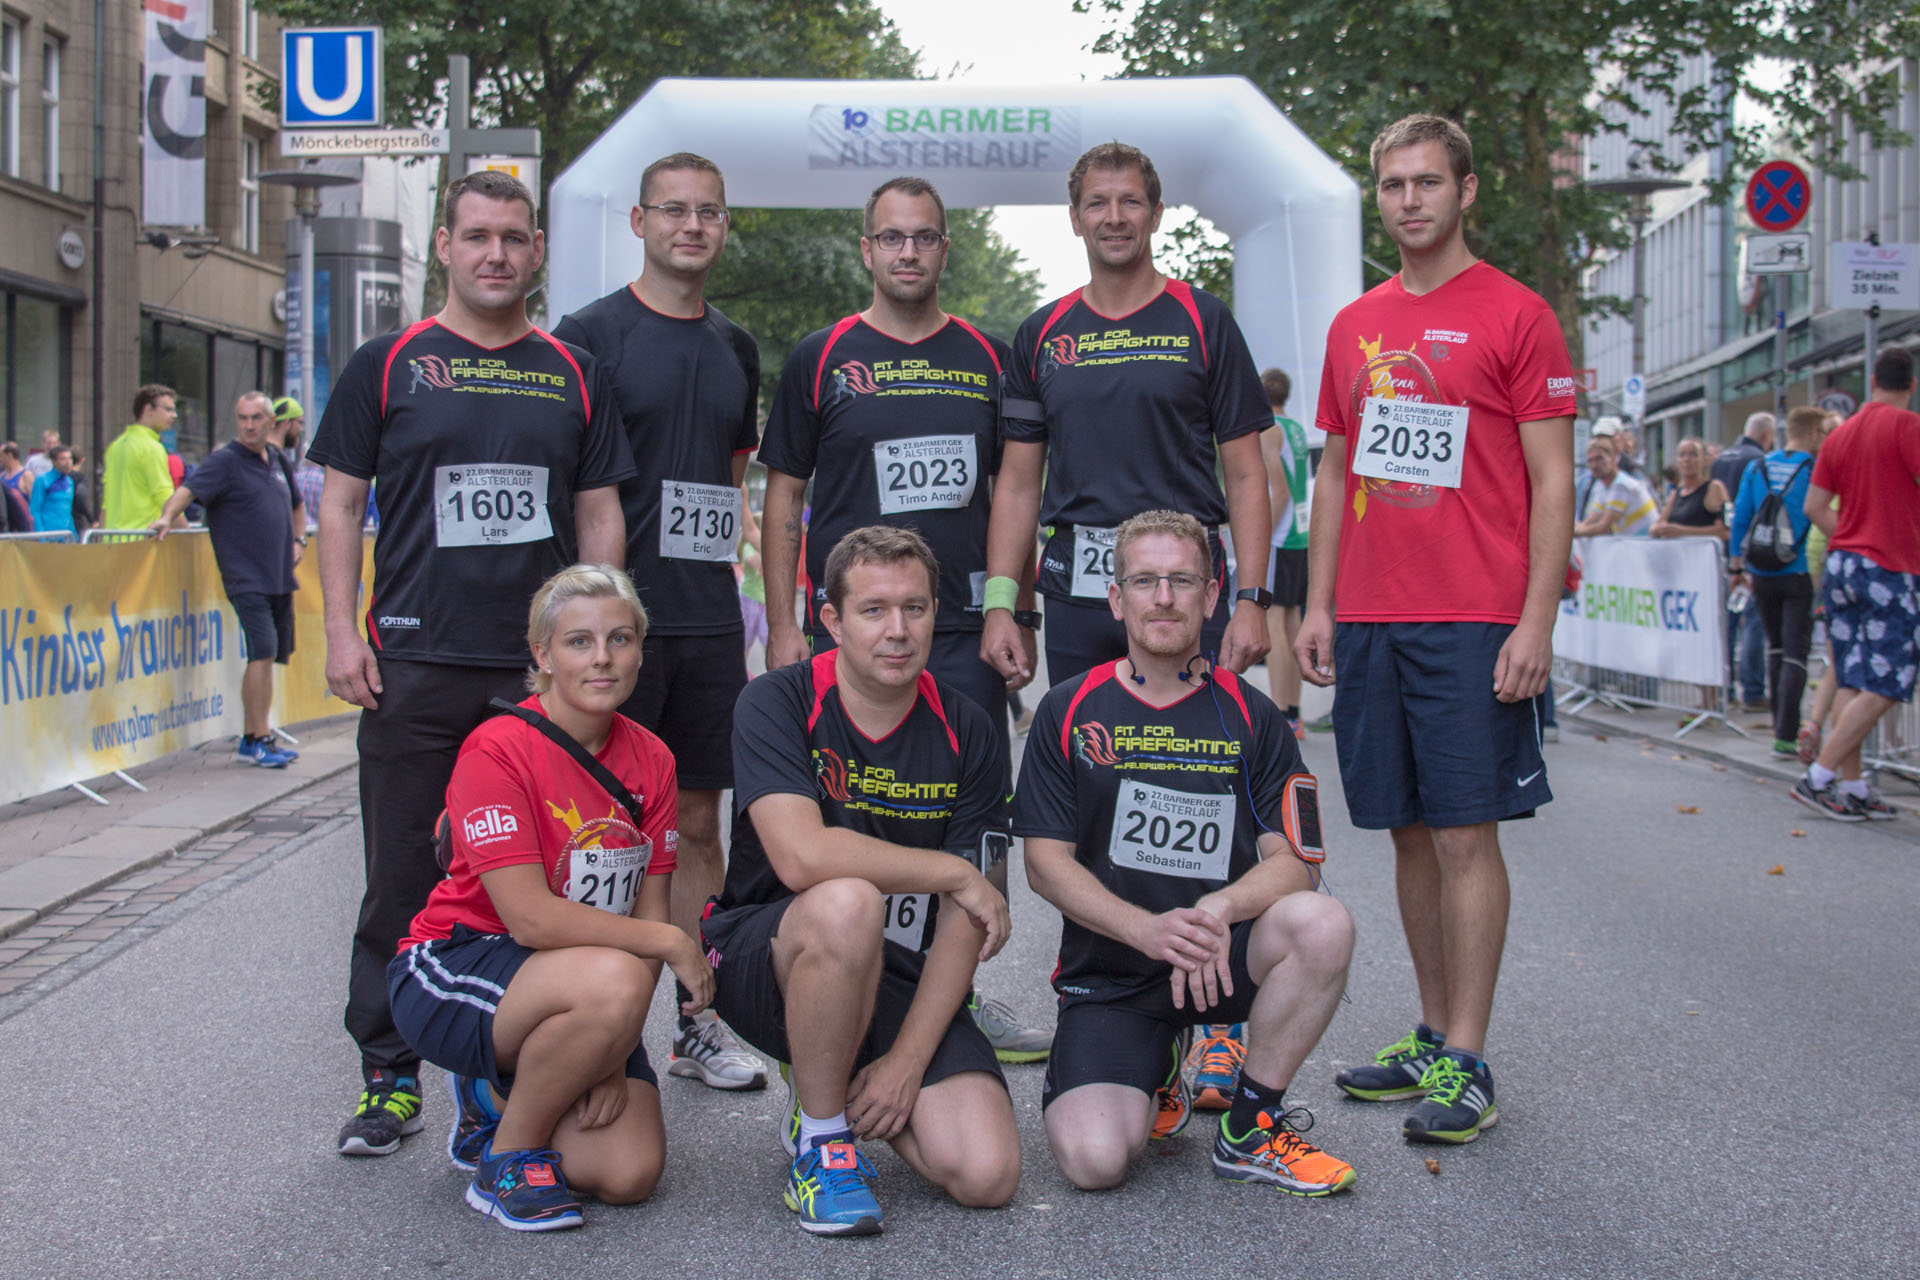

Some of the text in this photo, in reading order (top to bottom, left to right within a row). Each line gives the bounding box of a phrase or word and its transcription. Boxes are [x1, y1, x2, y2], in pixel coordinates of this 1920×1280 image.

[297, 36, 362, 116] U
[885, 108, 1051, 133] BARMER
[290, 133, 441, 152] Mönckebergstraße
[839, 140, 1050, 169] ALSTERLAUF
[1852, 270, 1899, 281] Zielzeit
[1852, 284, 1900, 294] 35 Min.
[1079, 329, 1131, 342] FIT FOR
[1077, 336, 1190, 353] FIREFIGHTING
[451, 358, 506, 368] FIT FOR
[873, 360, 930, 370] FIT FOR
[452, 367, 566, 387] FIREFIGHTING
[875, 369, 988, 386] FIREFIGHTING
[1404, 406, 1435, 415] BARMER
[1437, 409, 1454, 418] GEK
[1393, 413, 1453, 428] ALSTERLAUF
[914, 440, 947, 449] BARMER
[1367, 424, 1452, 463] 2033
[904, 446, 964, 458] ALSTERLAUF
[886, 458, 969, 492] 2023
[1384, 461, 1429, 477] Carsten
[467, 476, 533, 486] ALSTERLAUF
[696, 487, 722, 497] BARMER
[723, 490, 735, 498] GEK
[898, 491, 962, 505] Timo André
[448, 489, 536, 522] 1603
[688, 495, 735, 507] ALSTERLAUF
[668, 505, 734, 540] 2130
[481, 526, 509, 537] Lars
[693, 542, 711, 554] Eric
[1584, 583, 1699, 632] BARMER GEK
[0, 589, 223, 705] Kinder brauchen
[1114, 726, 1174, 737] FIT FOR
[1114, 737, 1241, 755] FIREFIGHTING
[864, 766, 895, 781] FOR
[1163, 793, 1202, 806] BARMER
[1203, 799, 1221, 807] GEK
[1150, 800, 1221, 818] ALSTERLAUF
[464, 809, 518, 842] hella
[1122, 810, 1220, 854] 2020
[613, 847, 640, 857] BARMER
[1135, 850, 1201, 870] Sebastian
[579, 866, 645, 907] 2110
